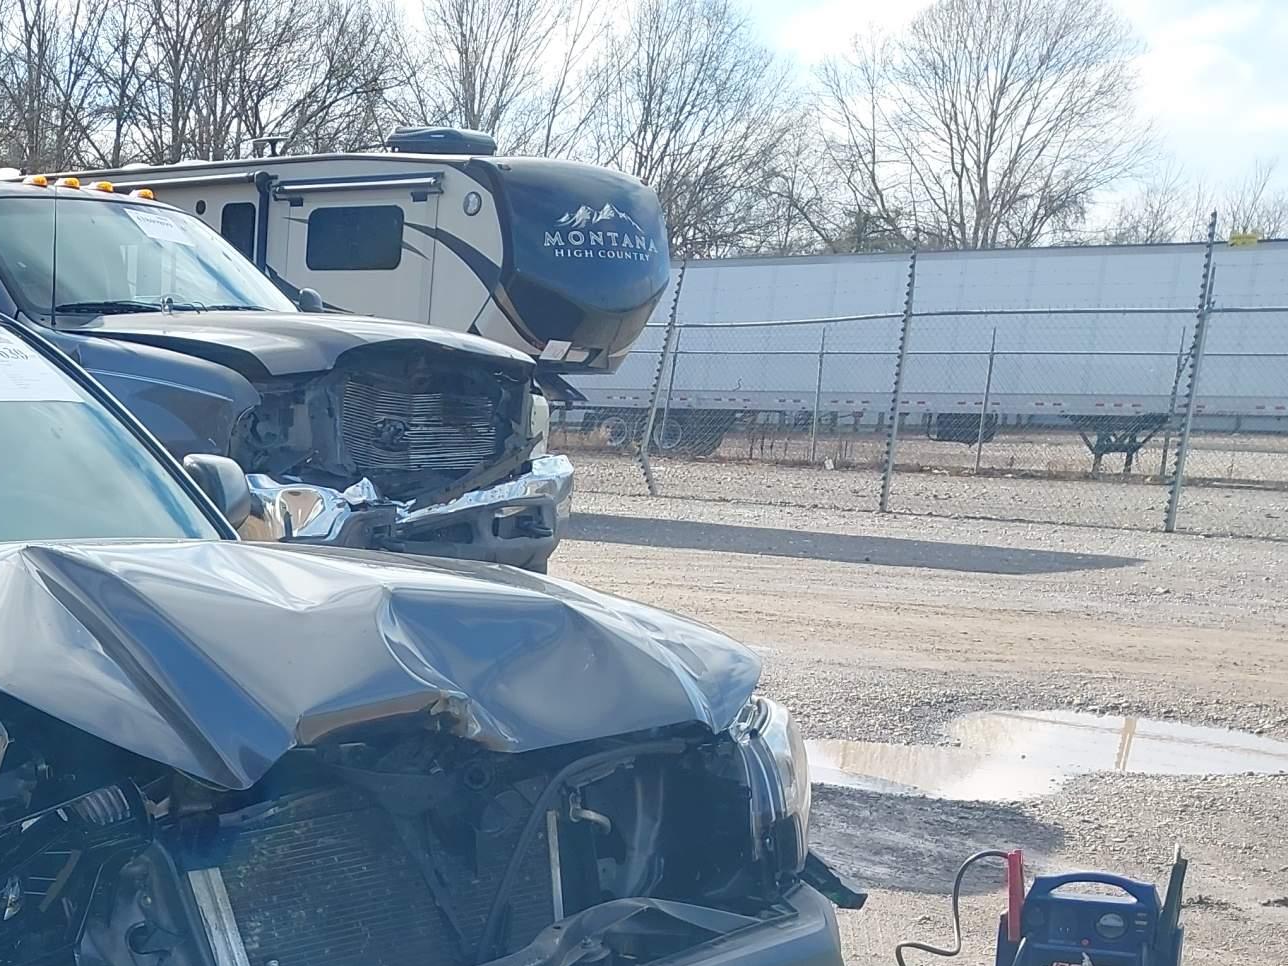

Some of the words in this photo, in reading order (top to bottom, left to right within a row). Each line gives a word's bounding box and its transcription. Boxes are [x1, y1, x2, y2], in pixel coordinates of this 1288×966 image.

[543, 230, 658, 253] MONTANA
[555, 249, 594, 258] HIGH
[598, 250, 650, 261] COUNTRY
